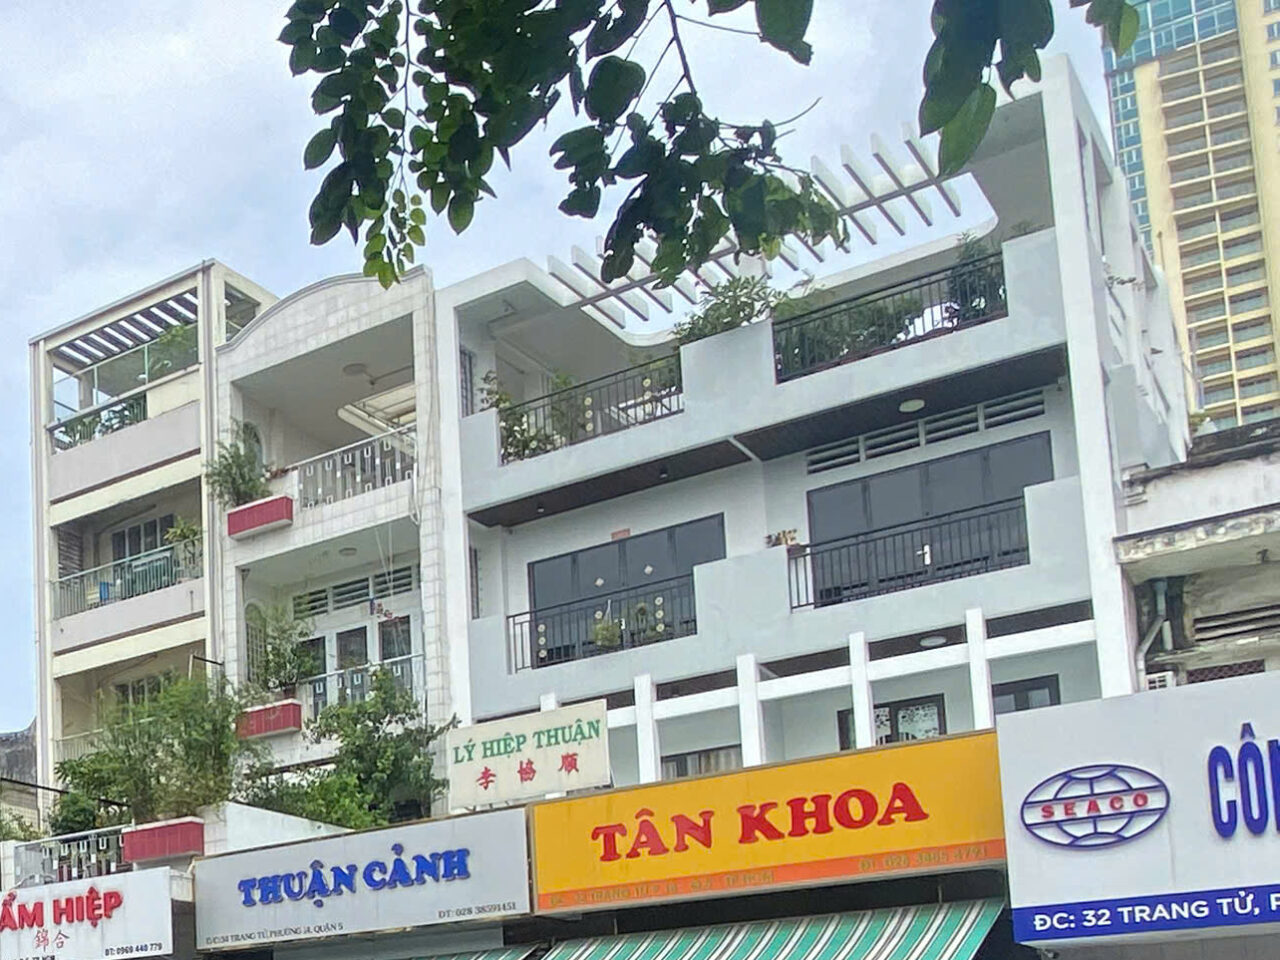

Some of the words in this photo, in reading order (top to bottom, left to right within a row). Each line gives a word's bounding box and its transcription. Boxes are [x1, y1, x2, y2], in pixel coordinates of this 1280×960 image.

[453, 738, 476, 764] LÝ
[482, 732, 526, 759] HIỆP
[532, 718, 601, 749] THUẬN
[591, 807, 715, 862] TÂN
[736, 782, 929, 844] KHOA
[1041, 793, 1149, 819] SEACO
[238, 860, 357, 908] THUẬN
[363, 843, 470, 891] CẢNH
[53, 886, 123, 928] HIỆP
[456, 907, 472, 916] 028
[1034, 913, 1075, 931] ĐC:
[1082, 909, 1112, 927] 32
[1117, 900, 1209, 924] TRANG
[1216, 891, 1260, 916] TỬ,
